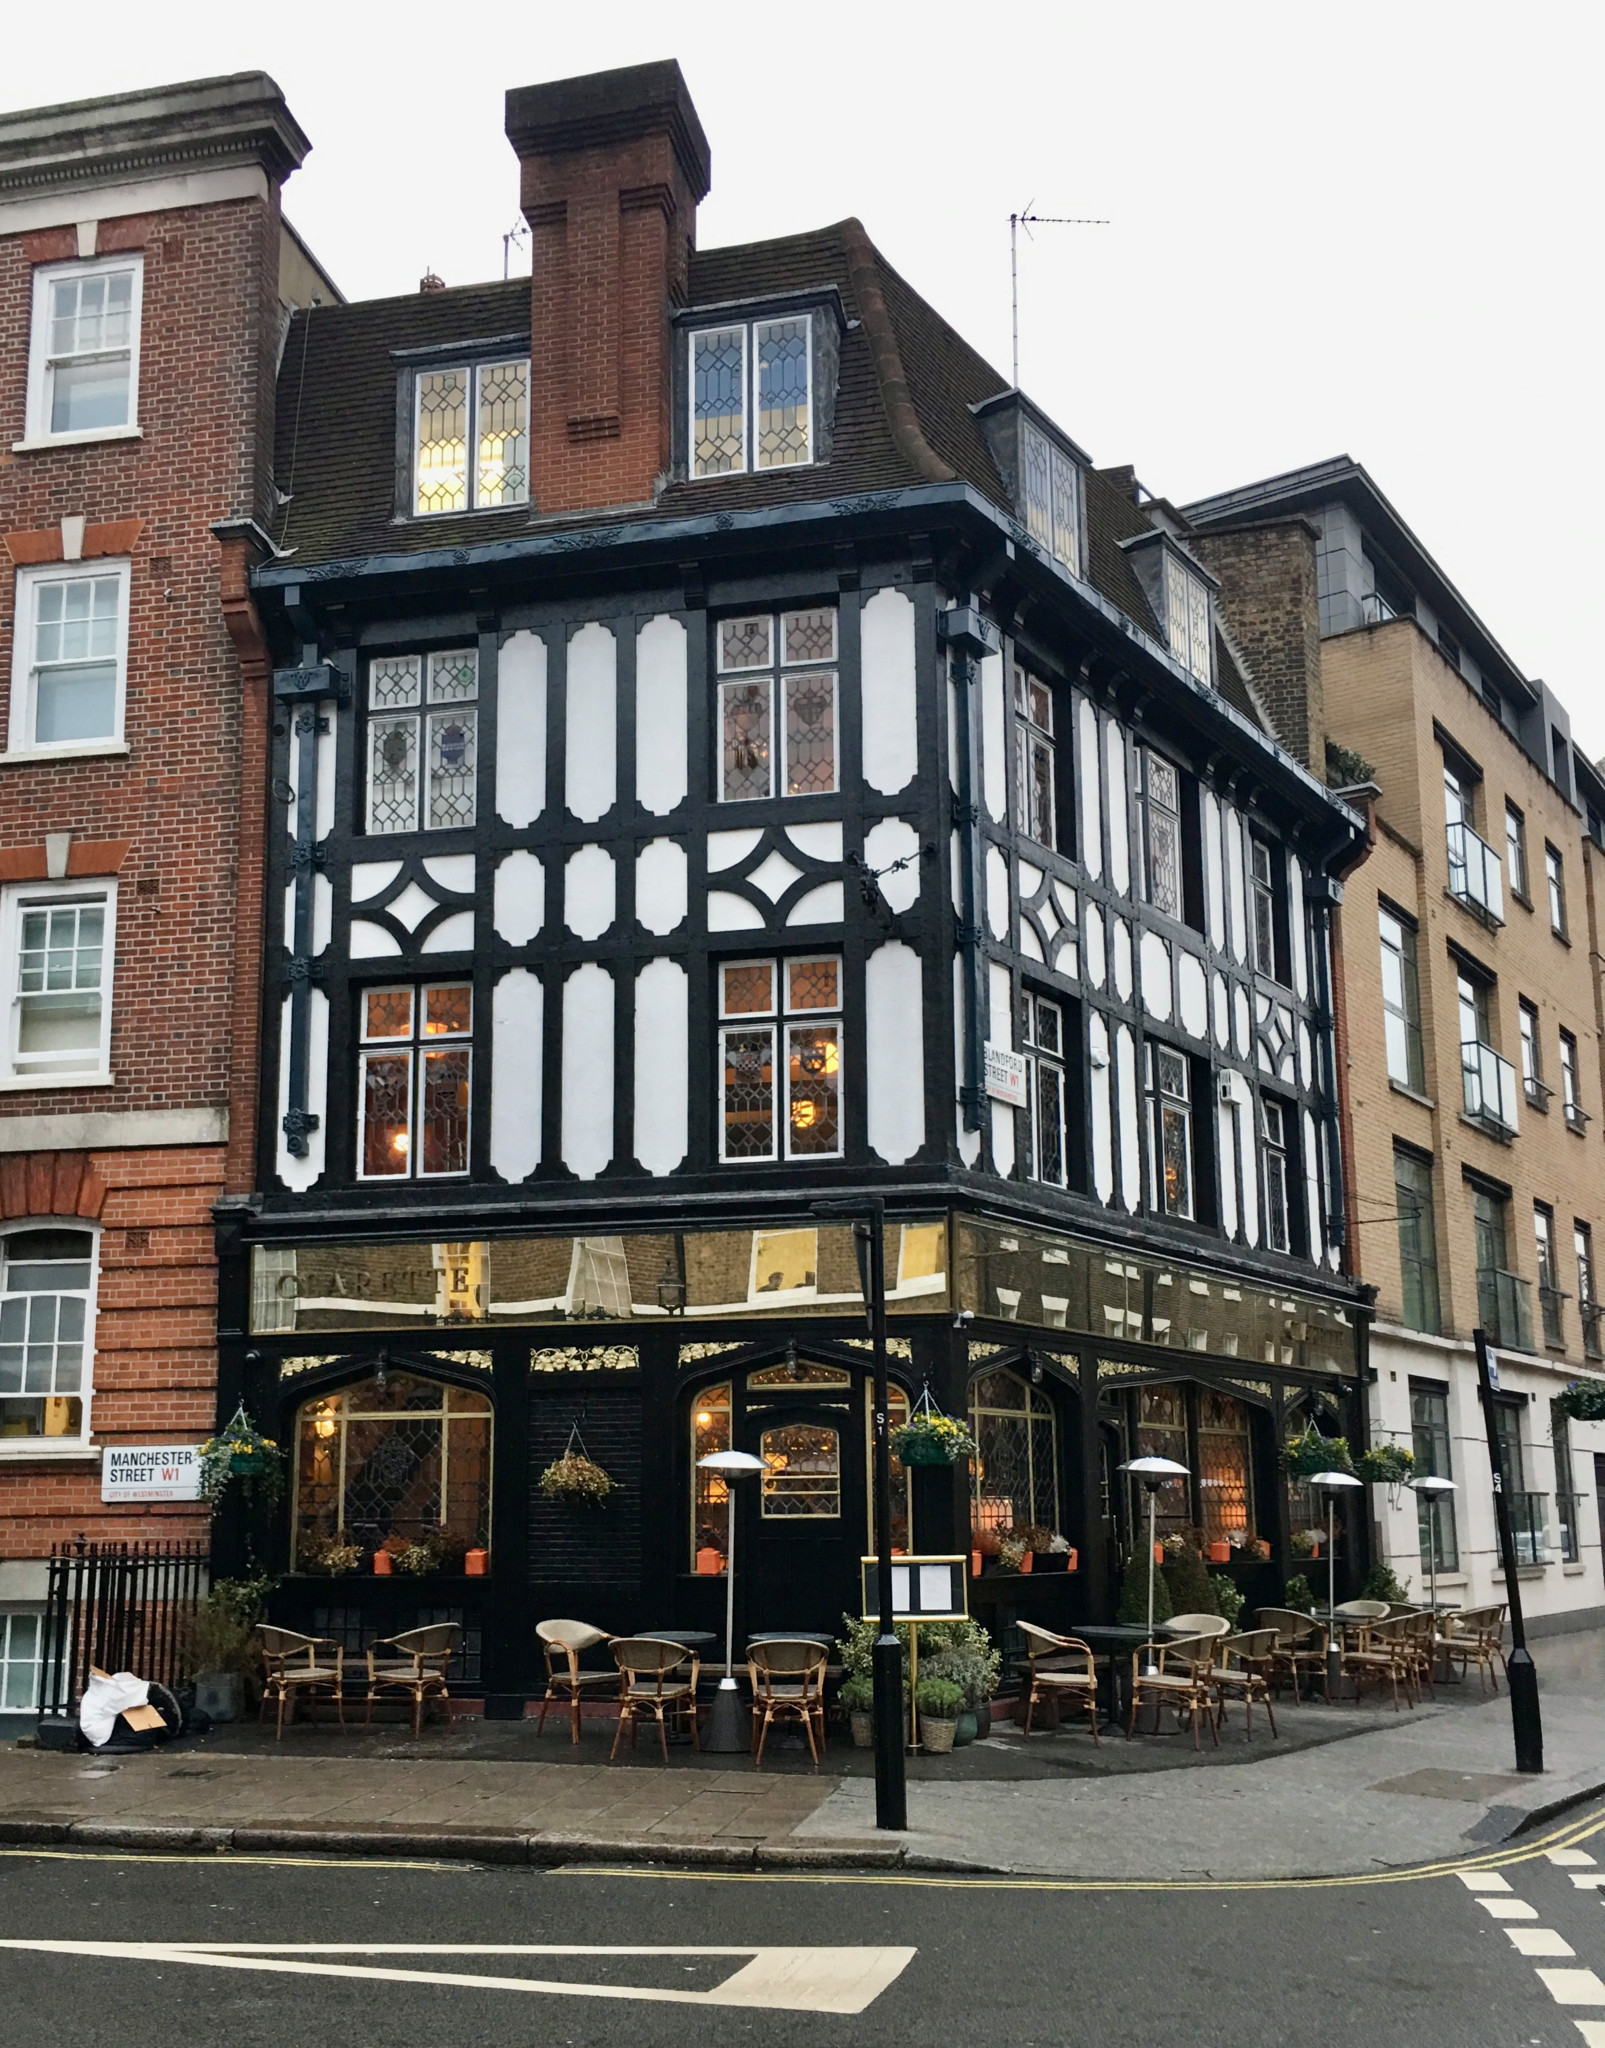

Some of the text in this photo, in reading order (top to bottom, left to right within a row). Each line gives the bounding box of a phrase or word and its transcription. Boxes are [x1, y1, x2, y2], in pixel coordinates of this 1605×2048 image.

[984, 1063, 1019, 1088] STREET W1
[110, 1451, 192, 1467] MANCHESTER
[110, 1467, 179, 1482] STREET W1
[109, 1489, 174, 1499] CITY OF WESTMINSTER
